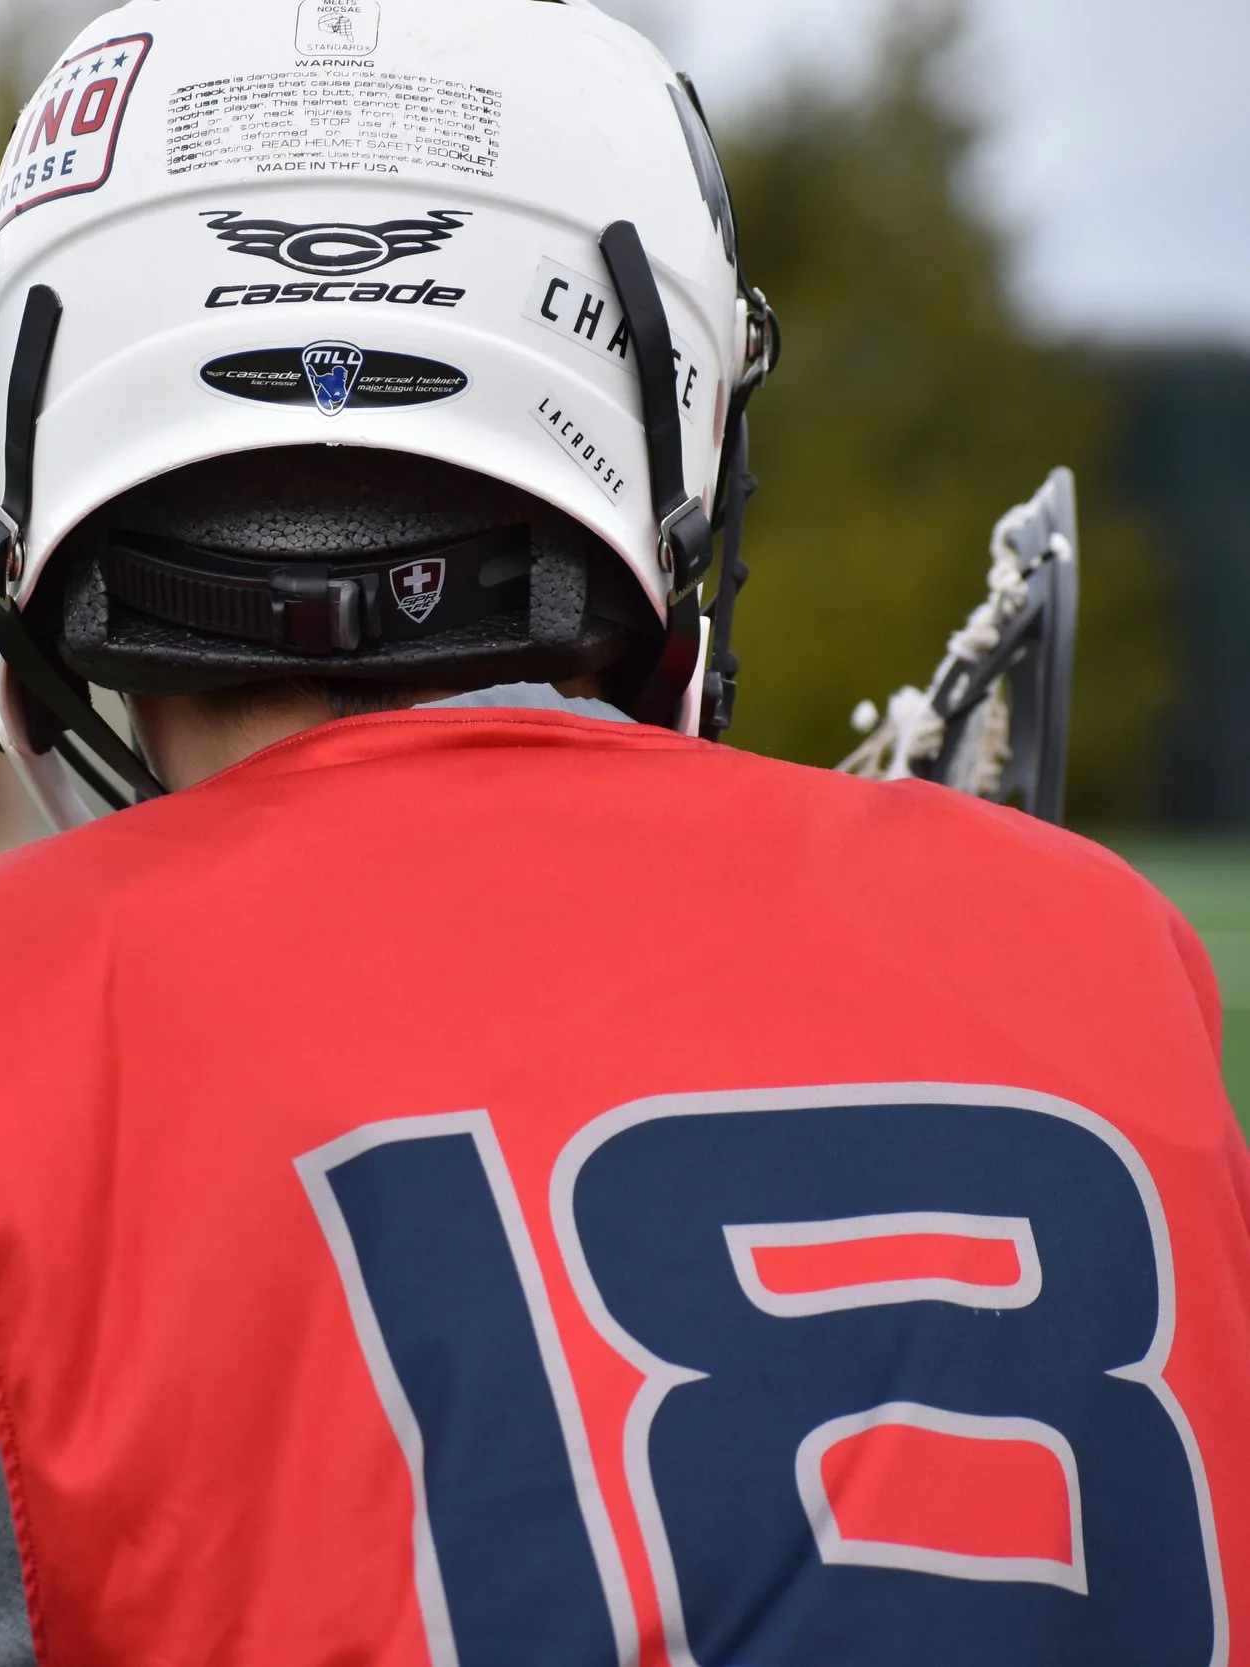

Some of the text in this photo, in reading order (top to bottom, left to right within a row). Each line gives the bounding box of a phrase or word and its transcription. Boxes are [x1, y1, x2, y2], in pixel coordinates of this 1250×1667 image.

[169, 92, 192, 105] and
[196, 88, 225, 98] neck
[230, 82, 274, 92] injuries
[354, 81, 413, 90] paralysis
[482, 96, 502, 108] Do
[353, 70, 375, 78] risk
[380, 72, 426, 82] severe
[470, 84, 502, 98] head
[168, 108, 219, 124] another
[354, 100, 400, 108] cannot
[405, 104, 458, 117] prevent
[195, 100, 218, 108] use
[224, 94, 247, 102] this
[252, 90, 298, 99] helmet
[322, 88, 354, 97] butt,
[396, 93, 434, 102] spear
[462, 103, 501, 117] strike
[264, 109, 294, 118] neck
[305, 108, 351, 117] injuries
[361, 109, 394, 118] from
[404, 112, 475, 130] intentional
[484, 128, 500, 136] or
[311, 118, 350, 126] STOP
[404, 123, 426, 132] the
[435, 127, 481, 142] helmet
[489, 138, 499, 147] is
[242, 129, 308, 140] deformed
[359, 131, 397, 139] inside
[416, 136, 470, 152] padding
[488, 148, 498, 157] is
[262, 139, 300, 148] READ
[306, 138, 362, 147] HELMET
[367, 140, 422, 152] SAFETY
[193, 160, 222, 170] other
[224, 154, 270, 164] warnings
[373, 152, 409, 162] helmet
[426, 160, 449, 168] your
[452, 164, 474, 174] own
[257, 162, 306, 172] MADE
[310, 162, 326, 170] IN
[364, 162, 398, 173] USA
[204, 279, 466, 308] cascade
[540, 277, 697, 409] CHAE
[305, 350, 360, 365] MLL
[226, 371, 301, 380] cascade
[357, 384, 384, 392] major
[416, 376, 464, 384] helmet
[538, 398, 624, 494] LACROSSE
[292, 1081, 1230, 1667] 18
